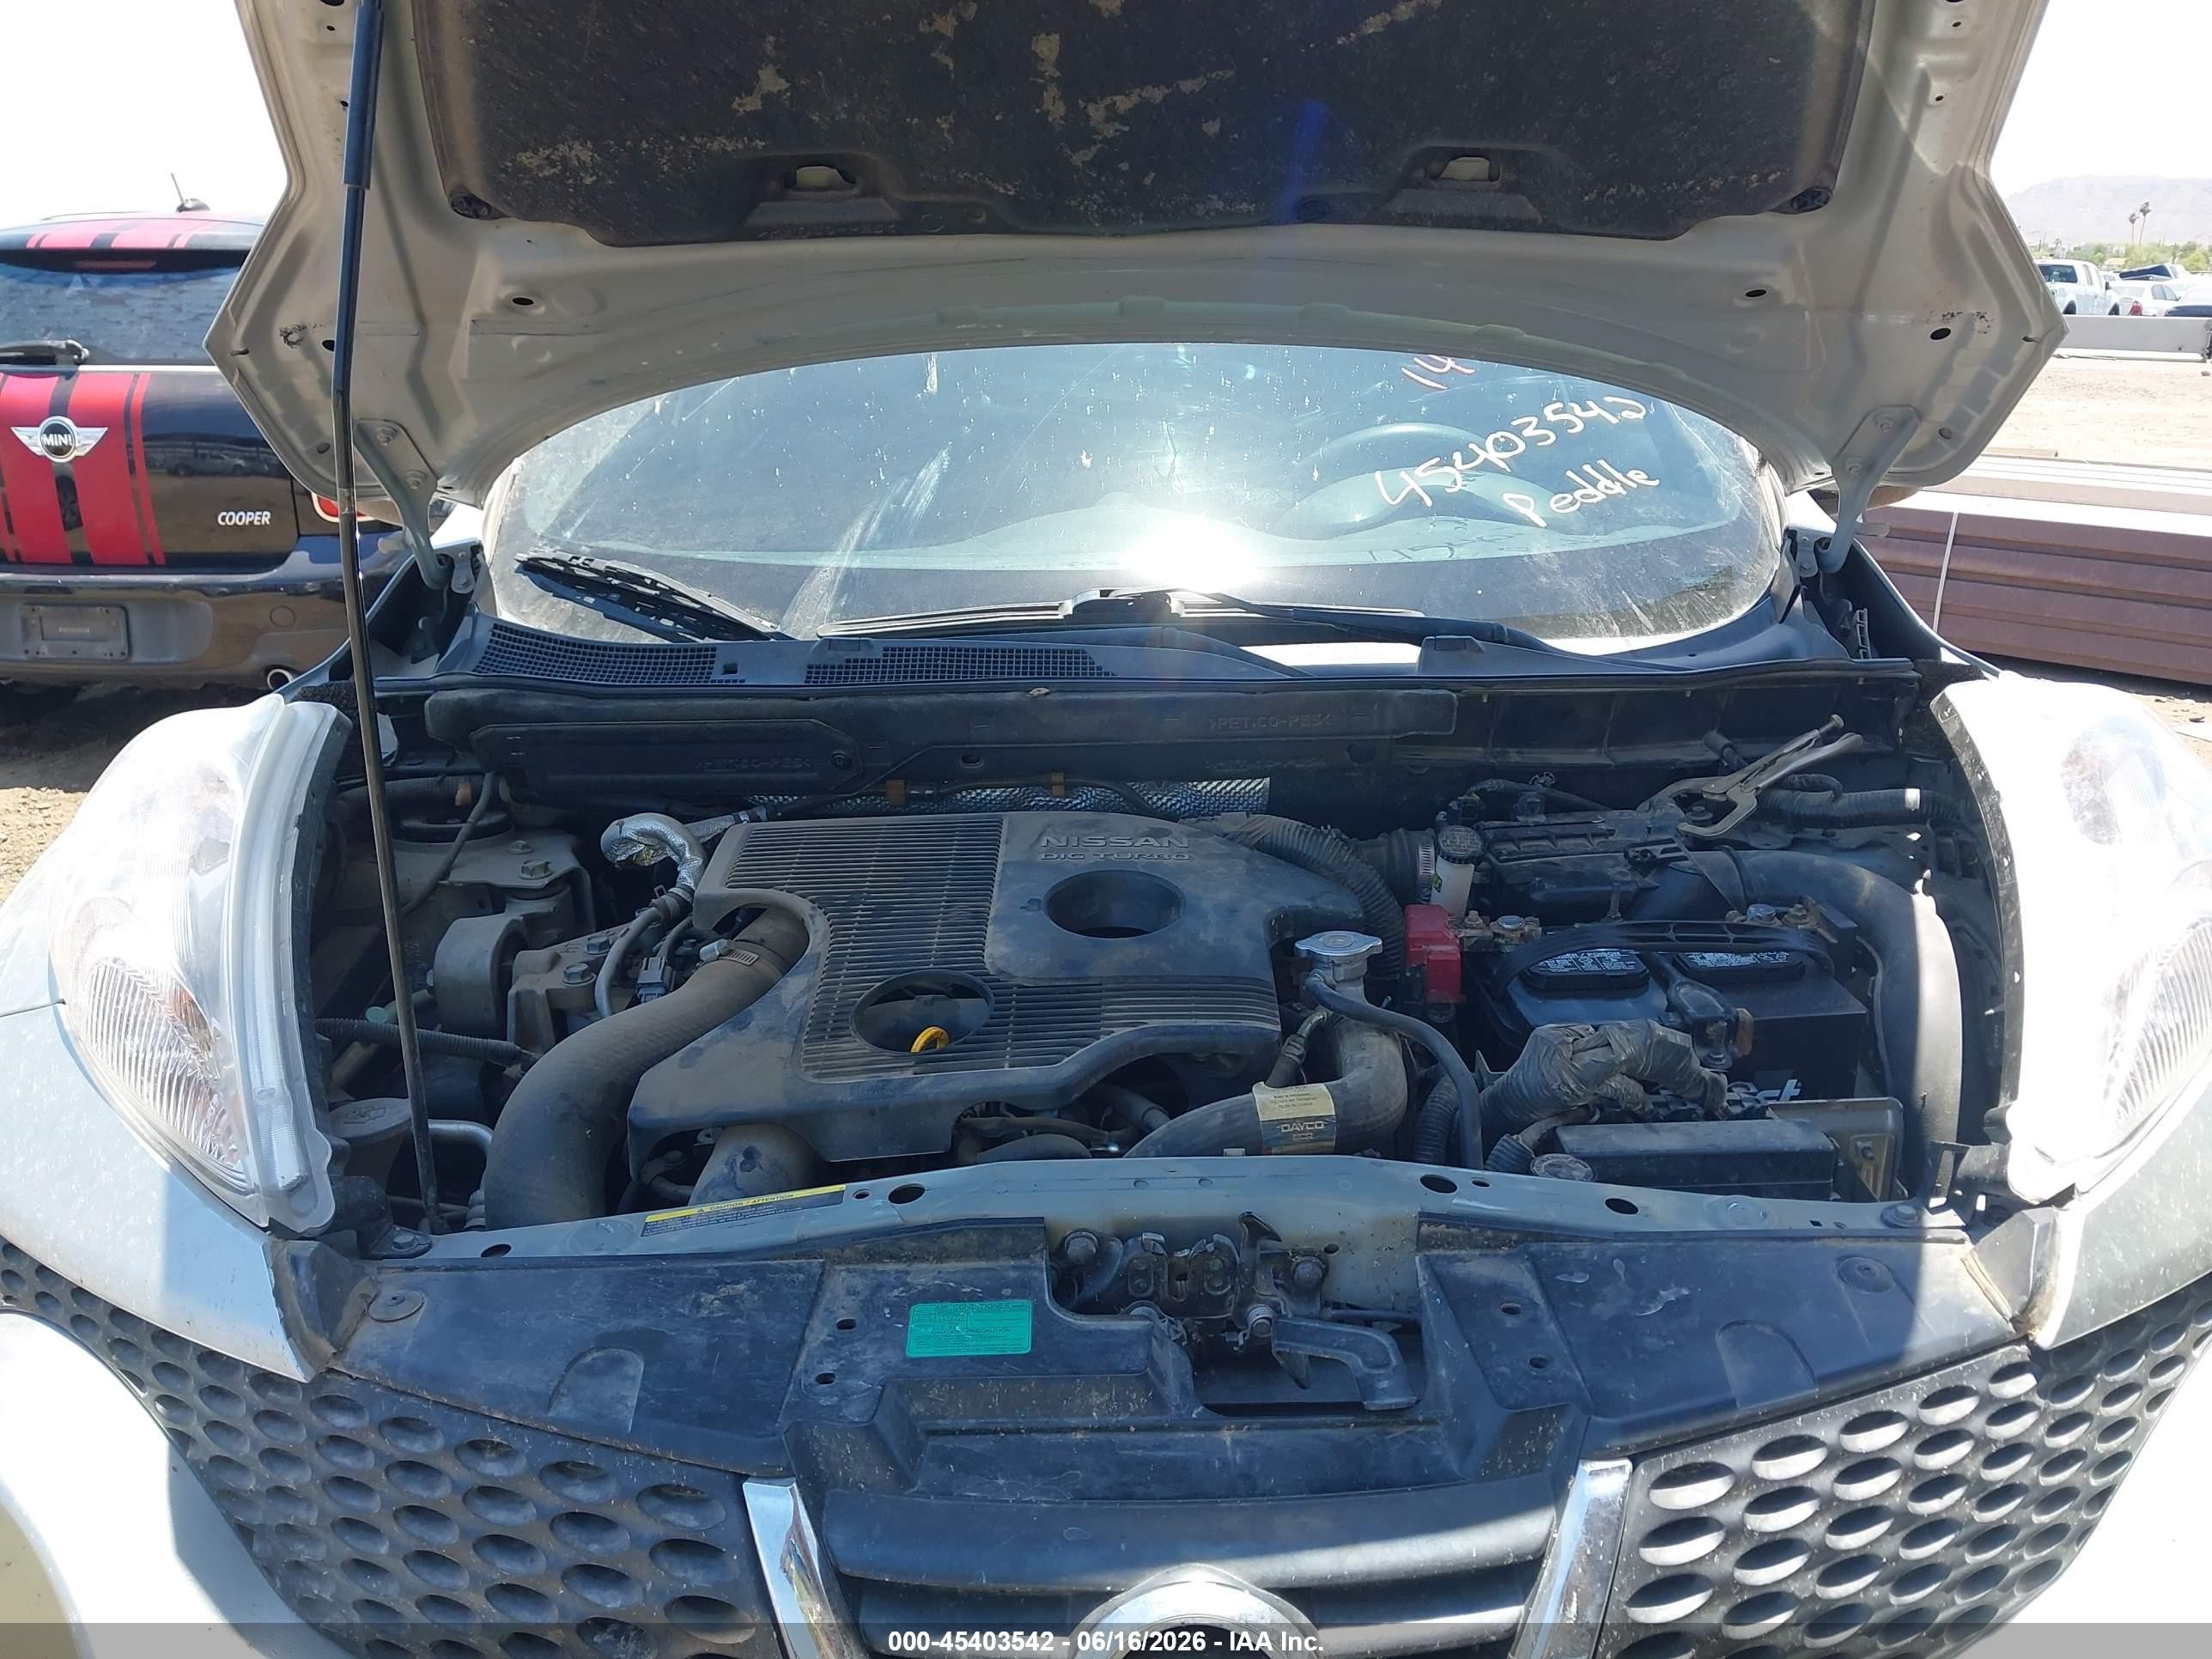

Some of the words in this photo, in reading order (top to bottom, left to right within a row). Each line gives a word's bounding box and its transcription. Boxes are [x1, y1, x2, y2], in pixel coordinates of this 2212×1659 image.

[42, 434, 72, 447] MINI
[1376, 396, 1647, 508] 45403542
[1503, 459, 1661, 527] Peddle
[217, 511, 271, 526] COOPER
[1041, 836, 1189, 848] NISSAN
[1280, 1121, 1325, 1133] DAYCO
